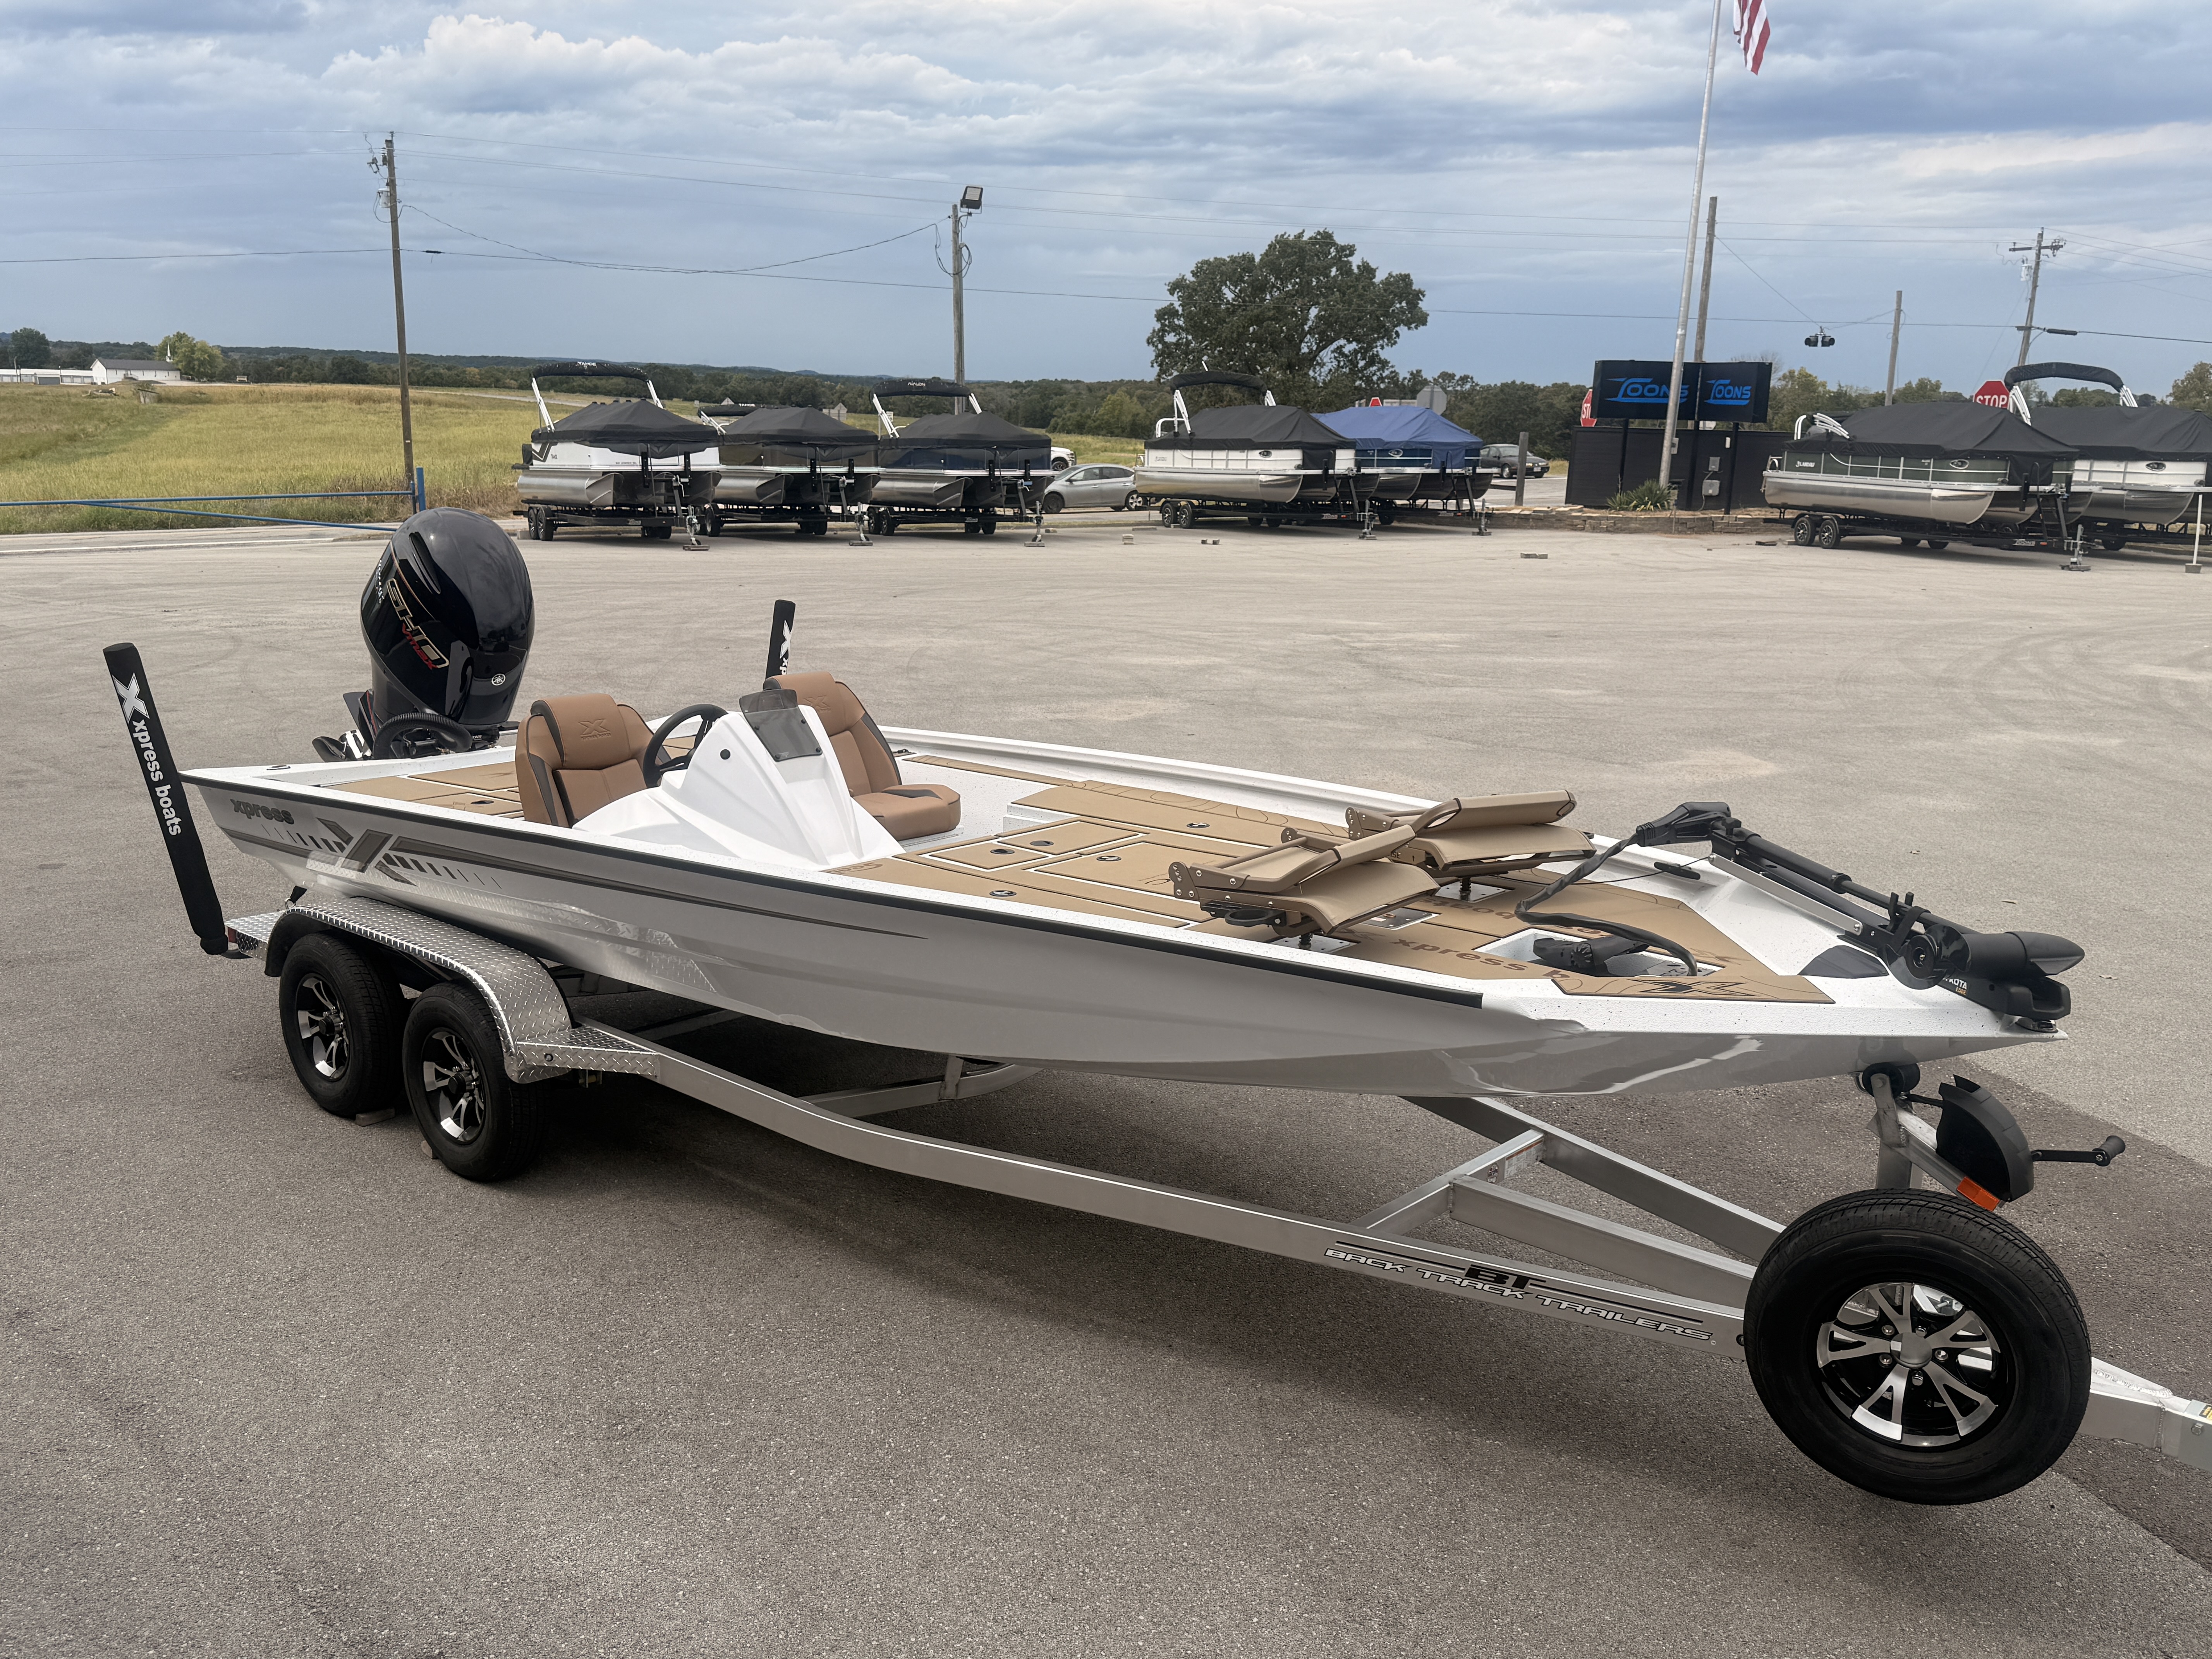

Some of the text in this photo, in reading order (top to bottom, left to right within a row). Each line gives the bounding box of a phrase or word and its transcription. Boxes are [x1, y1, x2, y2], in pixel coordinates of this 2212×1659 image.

[1705, 379, 1752, 405] TOONS
[1977, 395, 2007, 408] STOP
[1582, 403, 1591, 419] ST
[132, 719, 182, 836] xpress boats
[230, 799, 294, 824] xpress
[1389, 938, 1528, 971] xpress
[1465, 1264, 1546, 1289] BT
[1324, 1248, 1712, 1341] BACK TRACK TRAILERS
